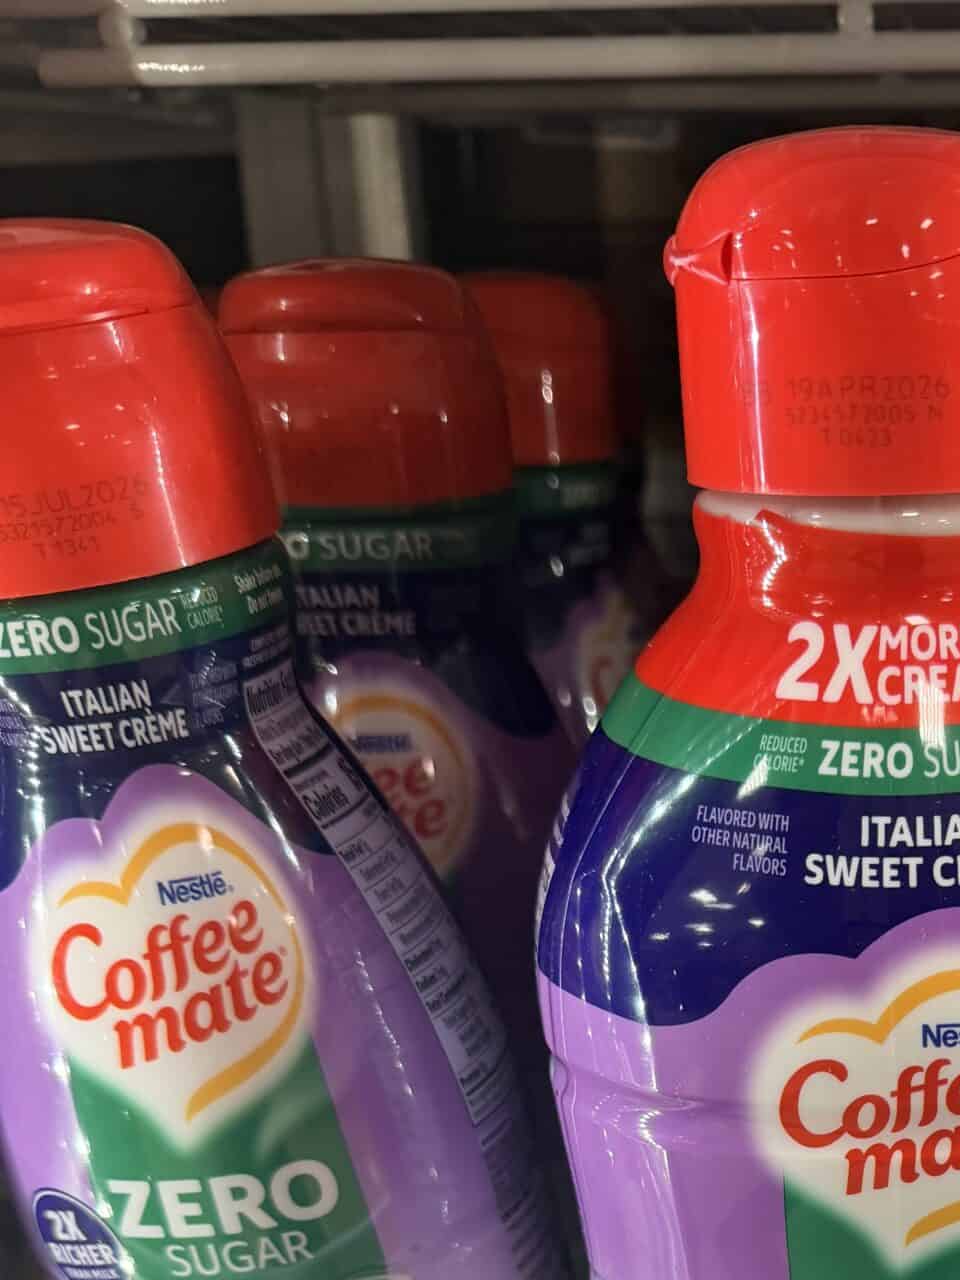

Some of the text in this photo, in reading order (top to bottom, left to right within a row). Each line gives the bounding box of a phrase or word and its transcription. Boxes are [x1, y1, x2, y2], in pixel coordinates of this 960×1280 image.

[319, 532, 433, 561] SUGAR
[296, 585, 379, 609] TALIAN
[84, 598, 182, 650] SUGAR
[775, 621, 878, 704] 2X
[60, 679, 153, 719] ITALIAN
[41, 719, 116, 755] SWEET
[118, 706, 191, 749] CRÈME
[759, 734, 808, 754] REDUCED
[817, 739, 914, 779] ZERO
[696, 804, 790, 832] FLAVORED WITH
[691, 826, 788, 855] OTHER NATURAL
[733, 854, 787, 877] FLAVORS
[803, 853, 924, 889] SWEET
[157, 870, 228, 907] Nestlé
[51, 899, 265, 1021] Coffee
[114, 951, 290, 1070] mate
[107, 1158, 340, 1242] ZERO
[43, 1210, 88, 1242] 2X
[47, 1241, 118, 1266] RICHER
[165, 1229, 315, 1279] SUGAR
